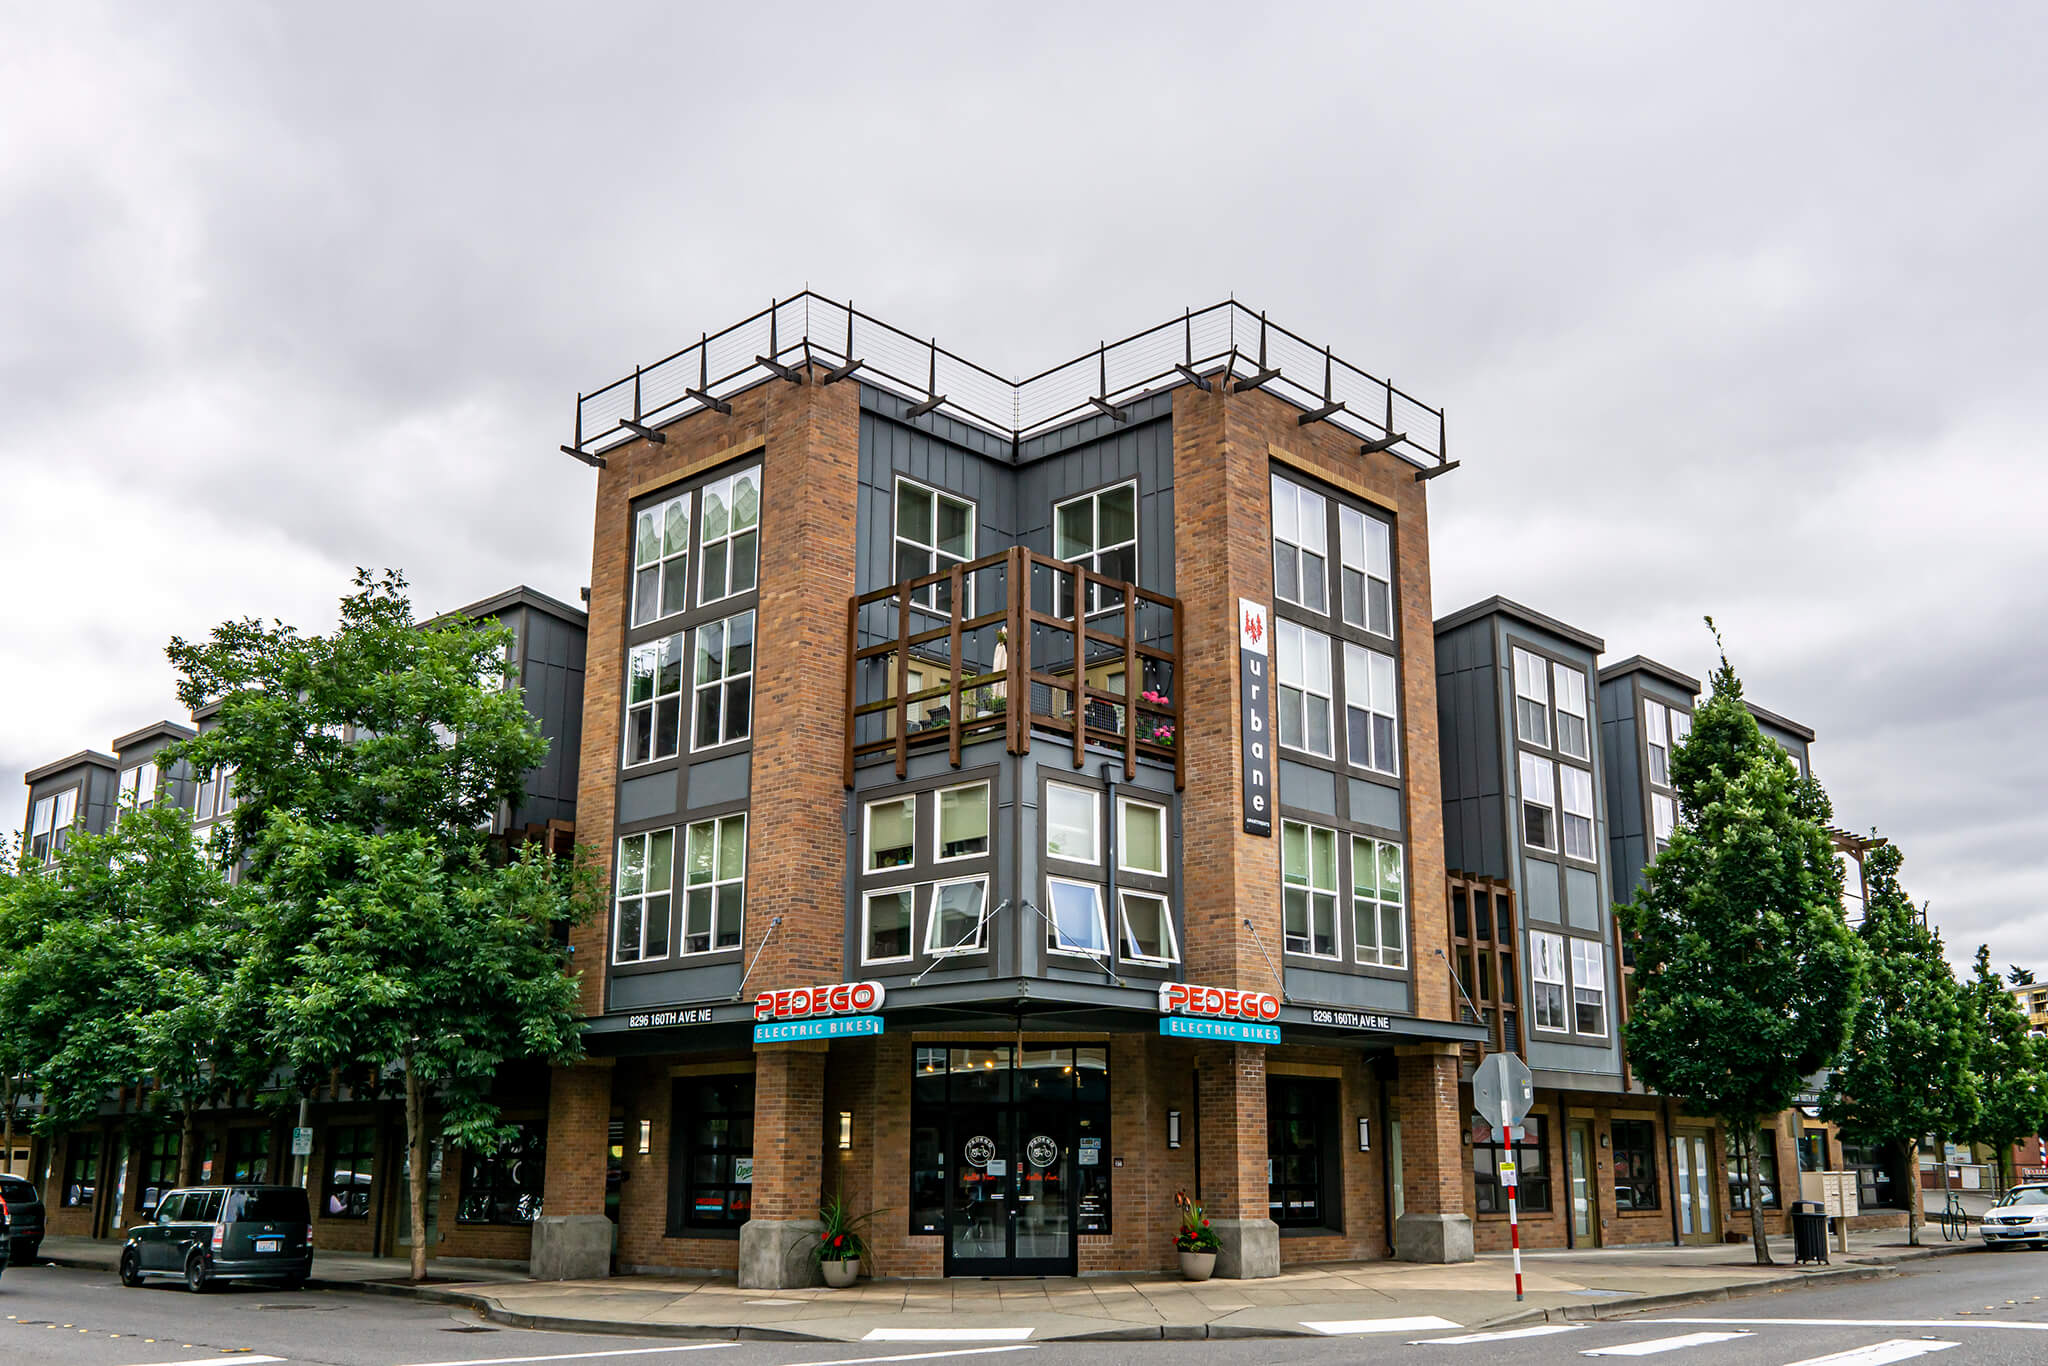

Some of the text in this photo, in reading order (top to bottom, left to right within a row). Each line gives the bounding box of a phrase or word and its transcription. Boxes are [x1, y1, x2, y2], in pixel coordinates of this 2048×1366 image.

[1249, 657, 1265, 812] urbane
[754, 982, 877, 1020] PEDEGO
[1168, 984, 1281, 1020] PEDEGO
[629, 1008, 712, 1027] 8296 160TH AVE NE
[1312, 1010, 1390, 1029] 8296 160TH AVE NE
[756, 1019, 873, 1039] ELECTRIC BIKES
[1171, 1020, 1280, 1041] ELECTRIC BIKES
